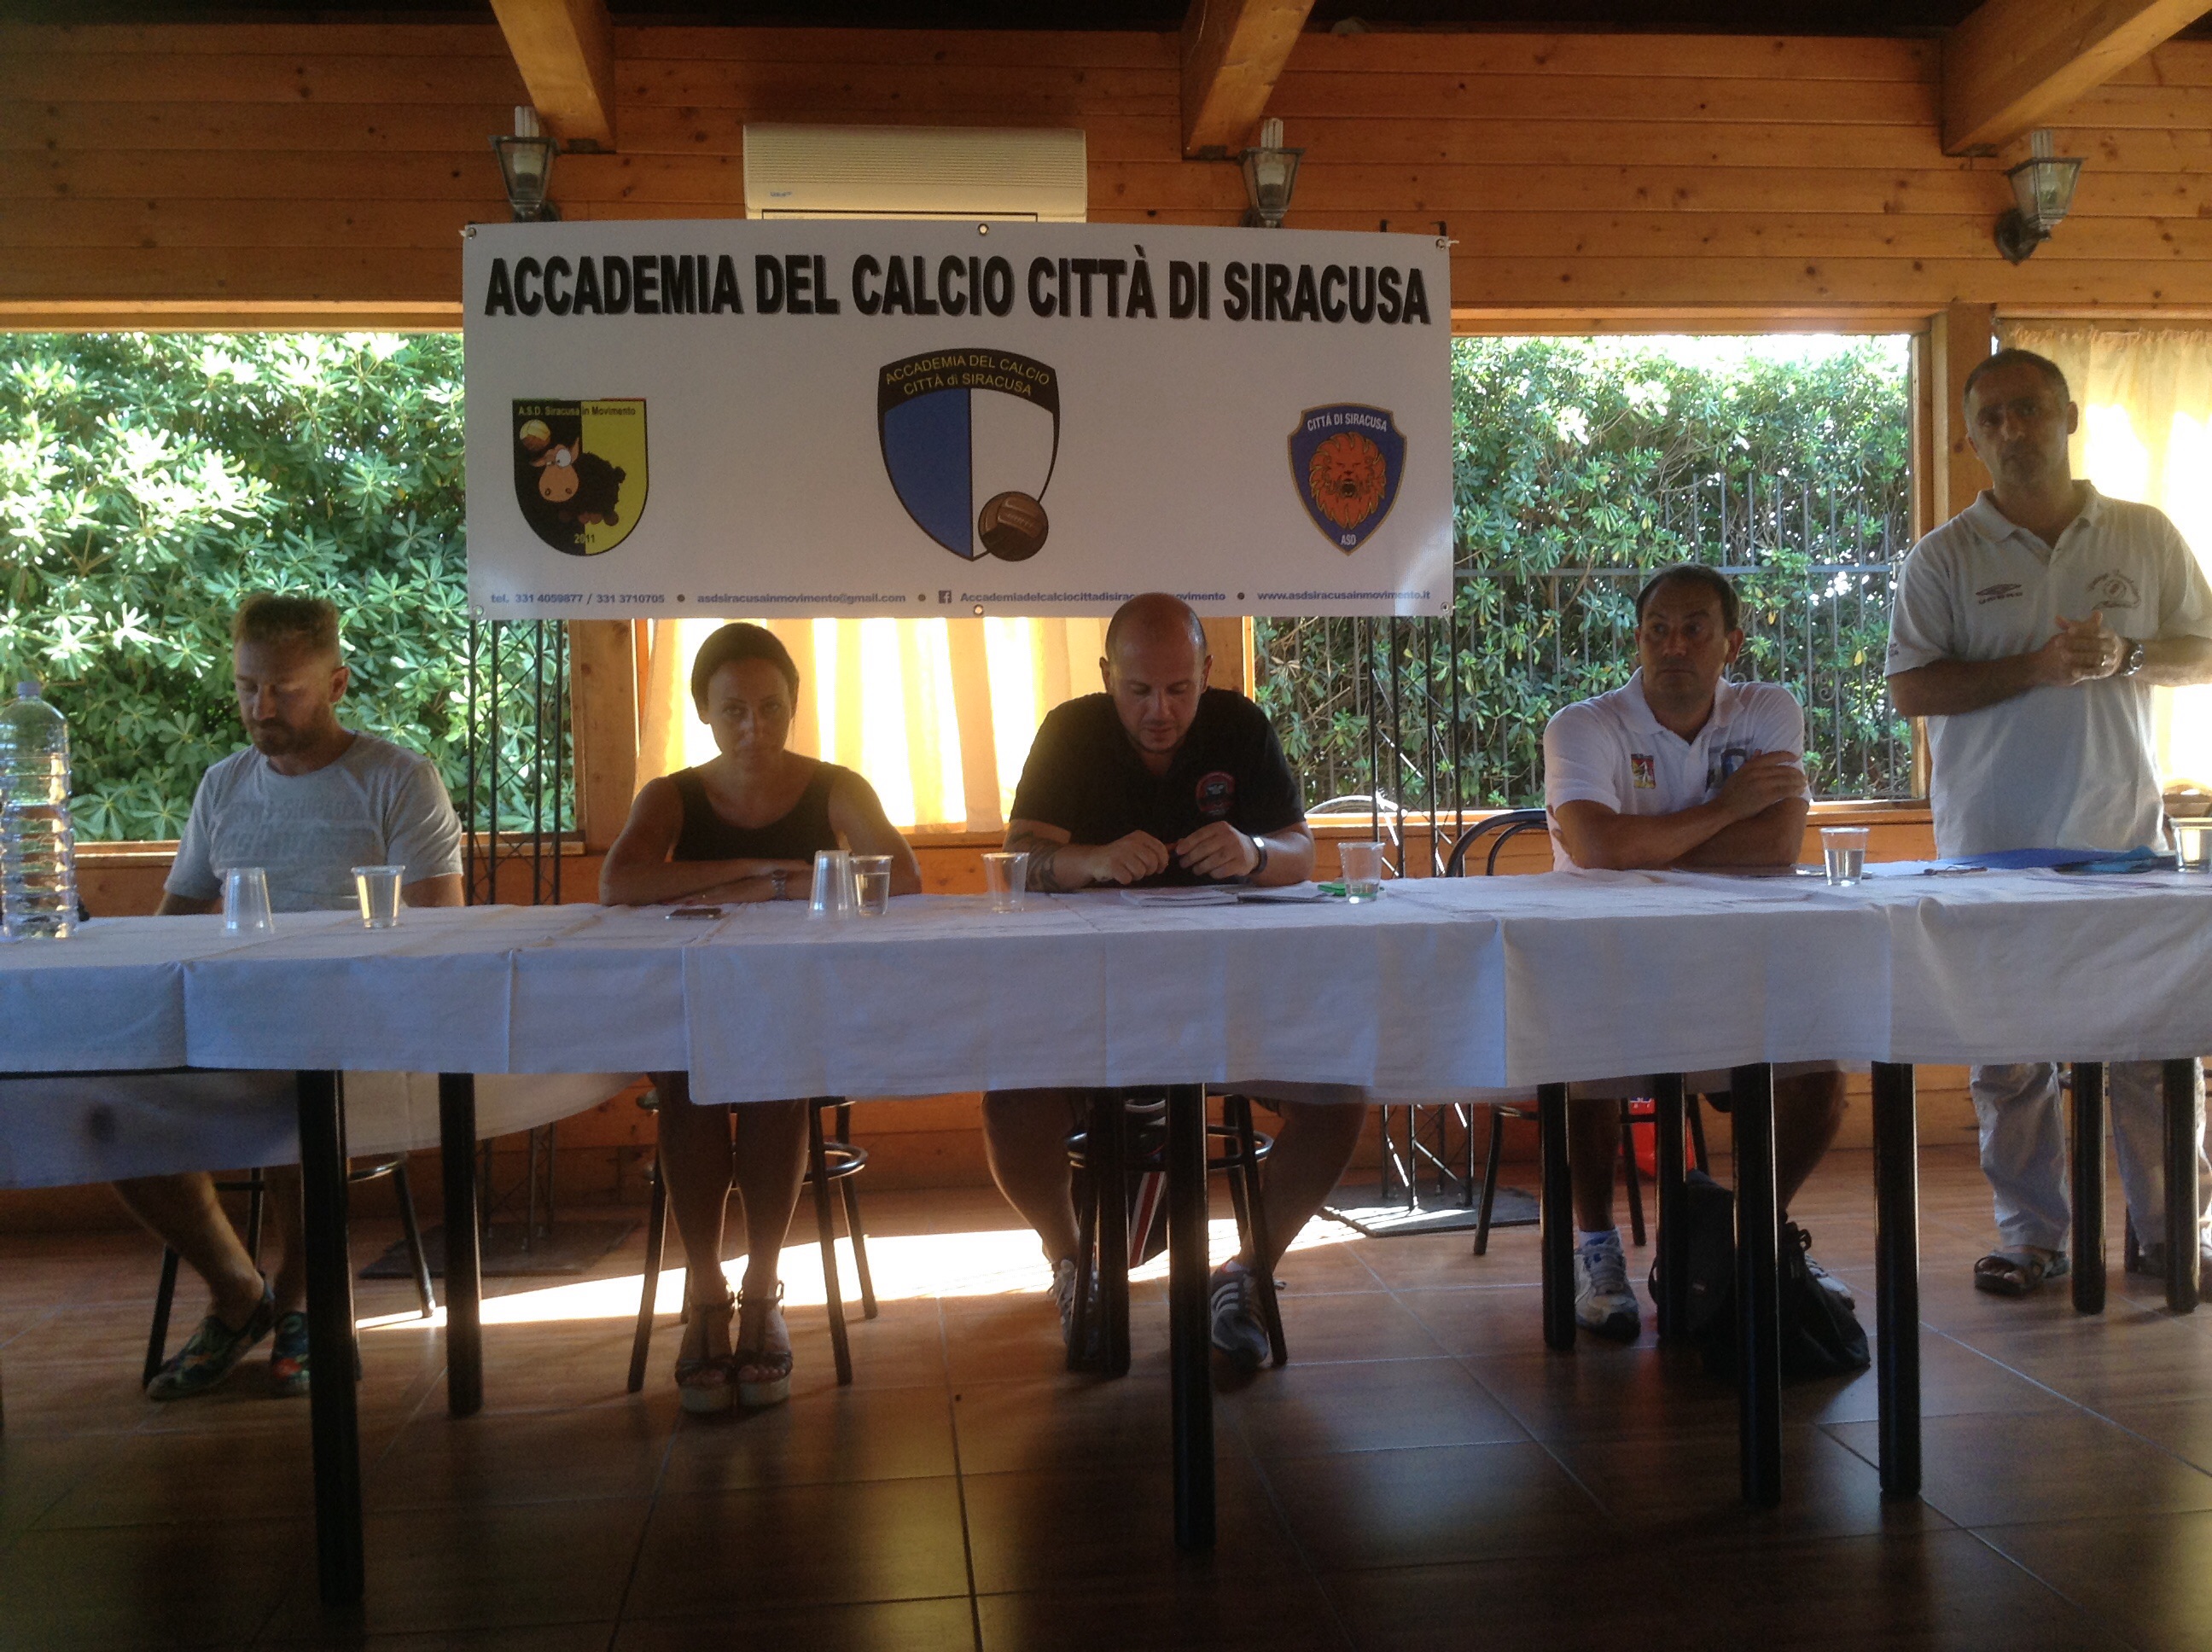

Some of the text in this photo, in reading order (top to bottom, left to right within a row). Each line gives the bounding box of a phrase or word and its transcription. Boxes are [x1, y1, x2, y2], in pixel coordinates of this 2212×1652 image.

[484, 244, 1431, 325] ACCADEMIA DEL CALCIO CITTÀ DI SIRACUSA
[886, 354, 1051, 386] ACCADEMIA DEL CALCIO
[903, 373, 1033, 398] CITTÀ di SIRACUSA
[591, 406, 636, 416] Movimento
[1333, 413, 1343, 426] DI
[1344, 412, 1388, 433] SIRACUSA
[573, 532, 595, 544] 2011
[1341, 533, 1357, 545] ASD
[515, 593, 534, 603] 331
[596, 593, 615, 603] 331
[620, 594, 665, 603] 3710705
